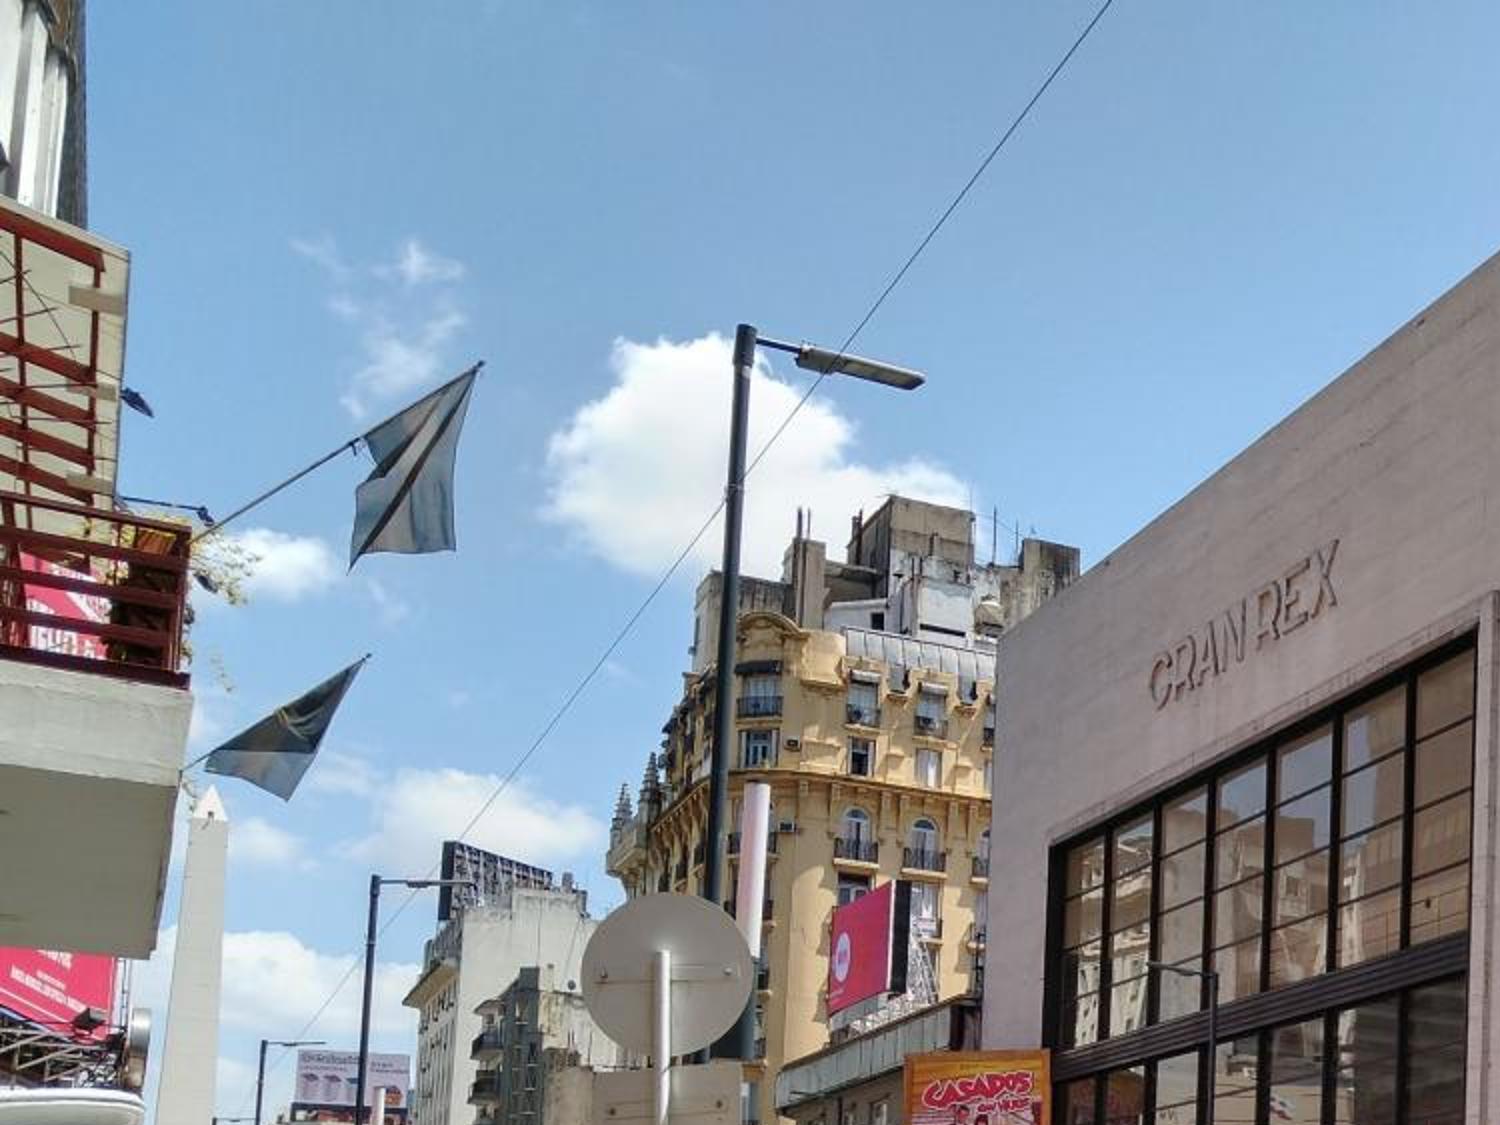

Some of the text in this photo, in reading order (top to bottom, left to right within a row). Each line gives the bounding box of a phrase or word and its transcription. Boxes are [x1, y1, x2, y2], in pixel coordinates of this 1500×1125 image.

[1150, 538, 1340, 710] GRAN REX
[921, 1070, 1033, 1111] CASADOS
